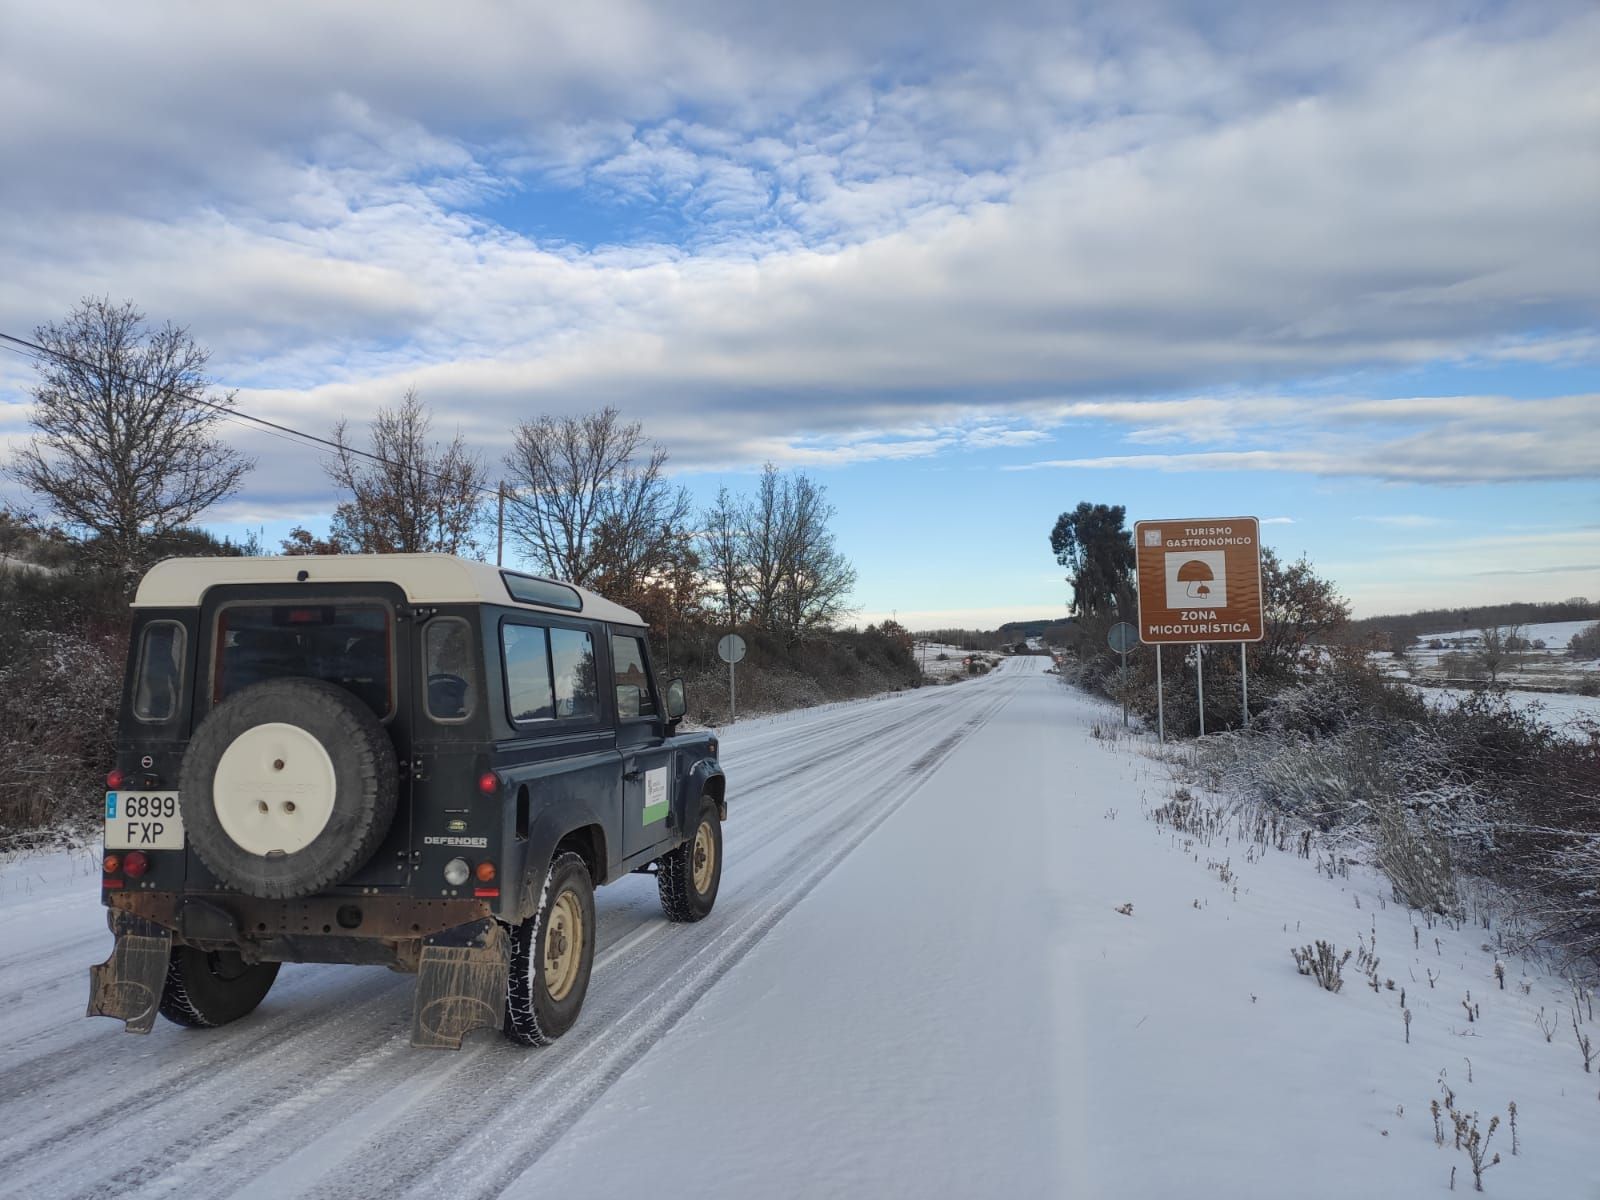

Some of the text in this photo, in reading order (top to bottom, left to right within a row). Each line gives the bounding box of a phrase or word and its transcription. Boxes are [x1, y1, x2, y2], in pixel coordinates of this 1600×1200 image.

[1184, 527, 1232, 536] TURISMO
[1181, 611, 1217, 621] ZONA
[1149, 622, 1251, 634] MICOTURÍSTICA
[125, 796, 175, 818] 6899
[127, 822, 164, 844] FXP
[424, 837, 488, 846] DEFENDER
